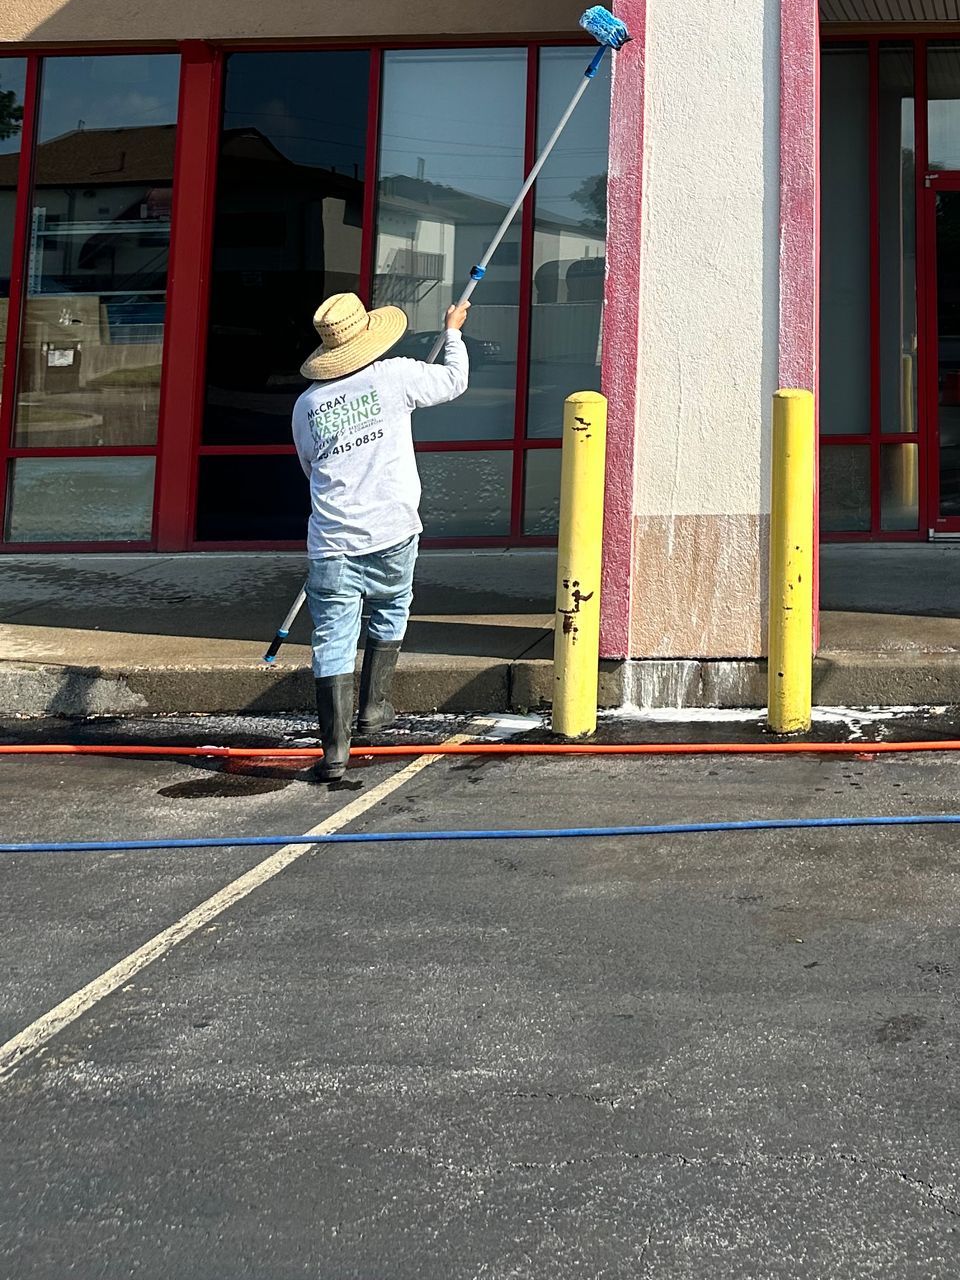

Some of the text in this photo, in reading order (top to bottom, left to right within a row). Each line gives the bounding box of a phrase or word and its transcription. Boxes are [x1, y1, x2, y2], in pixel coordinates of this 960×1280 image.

[307, 394, 346, 420] McCRAY
[308, 390, 378, 432] PRESSURE
[311, 403, 381, 442] WASHING
